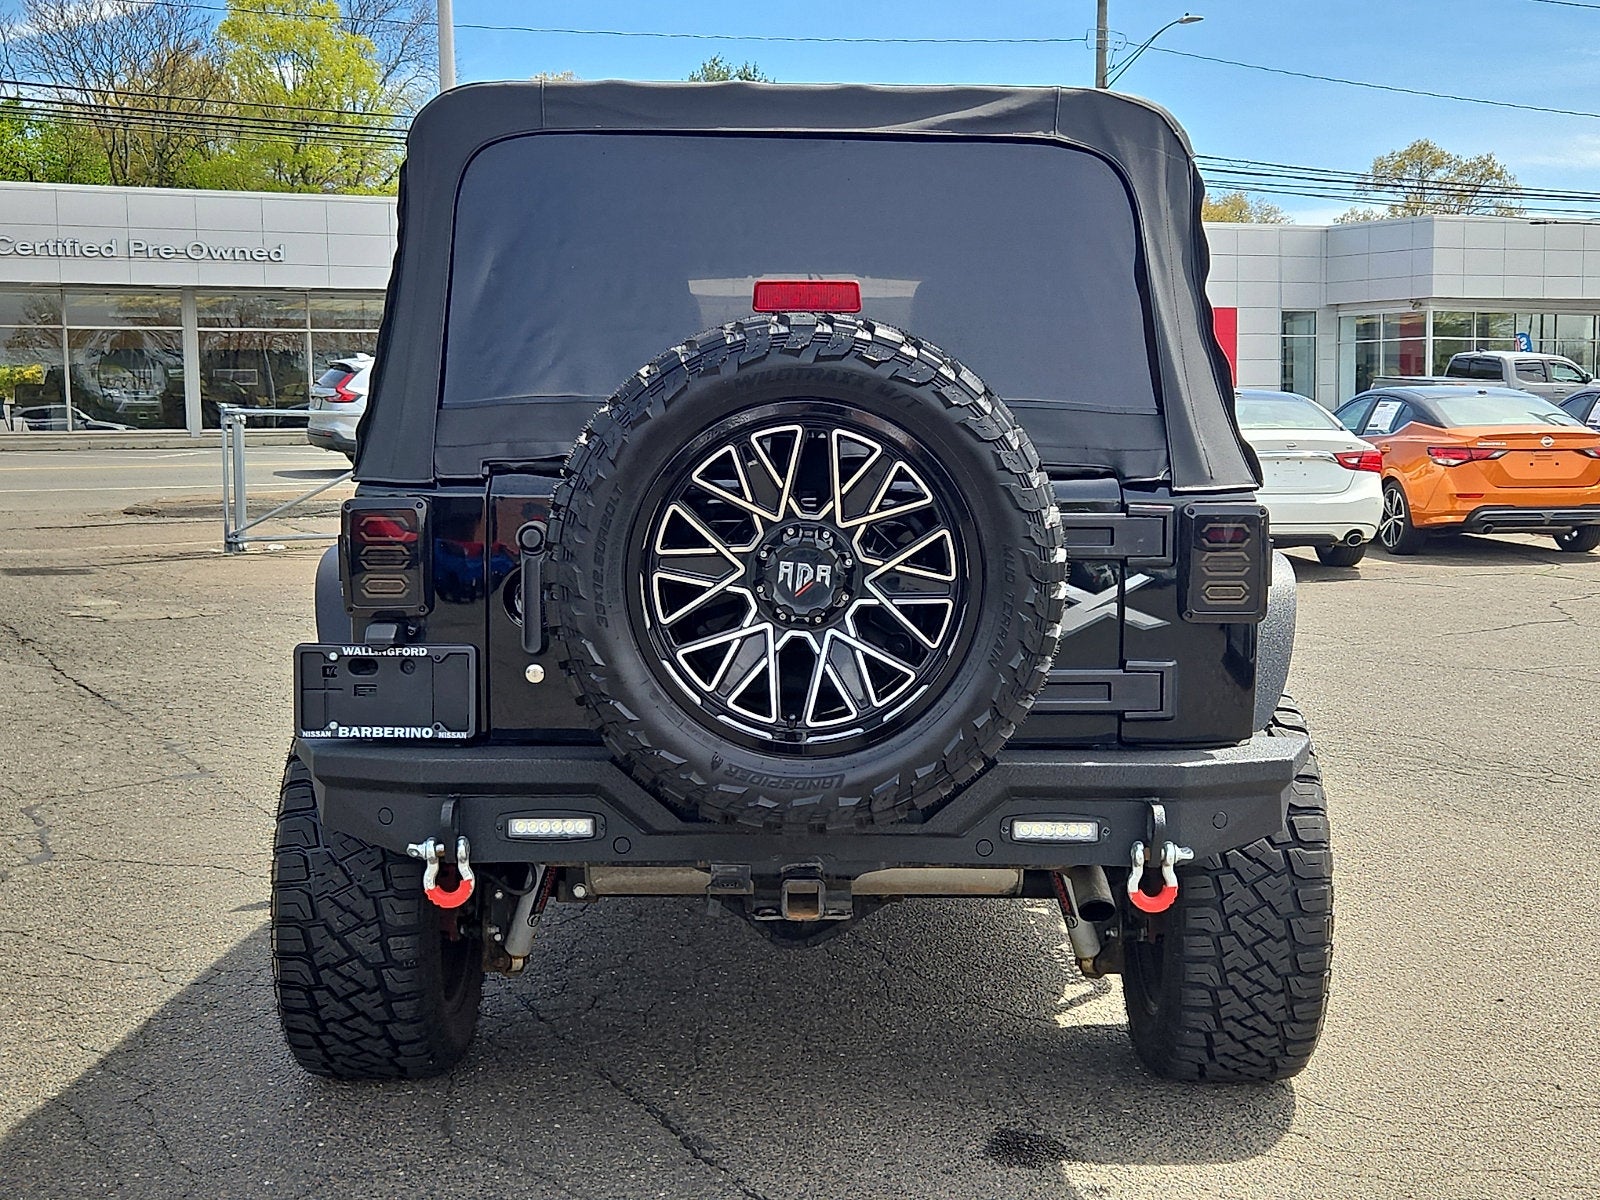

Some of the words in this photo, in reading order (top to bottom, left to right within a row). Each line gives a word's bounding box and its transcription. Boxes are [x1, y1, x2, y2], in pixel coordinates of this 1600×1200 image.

[0, 235, 118, 258] Certified
[127, 239, 286, 262] Pre-Owned
[1002, 543, 1016, 584] MUD
[338, 726, 433, 739] BARBERINO
[724, 763, 846, 790] LANDSPIDER
